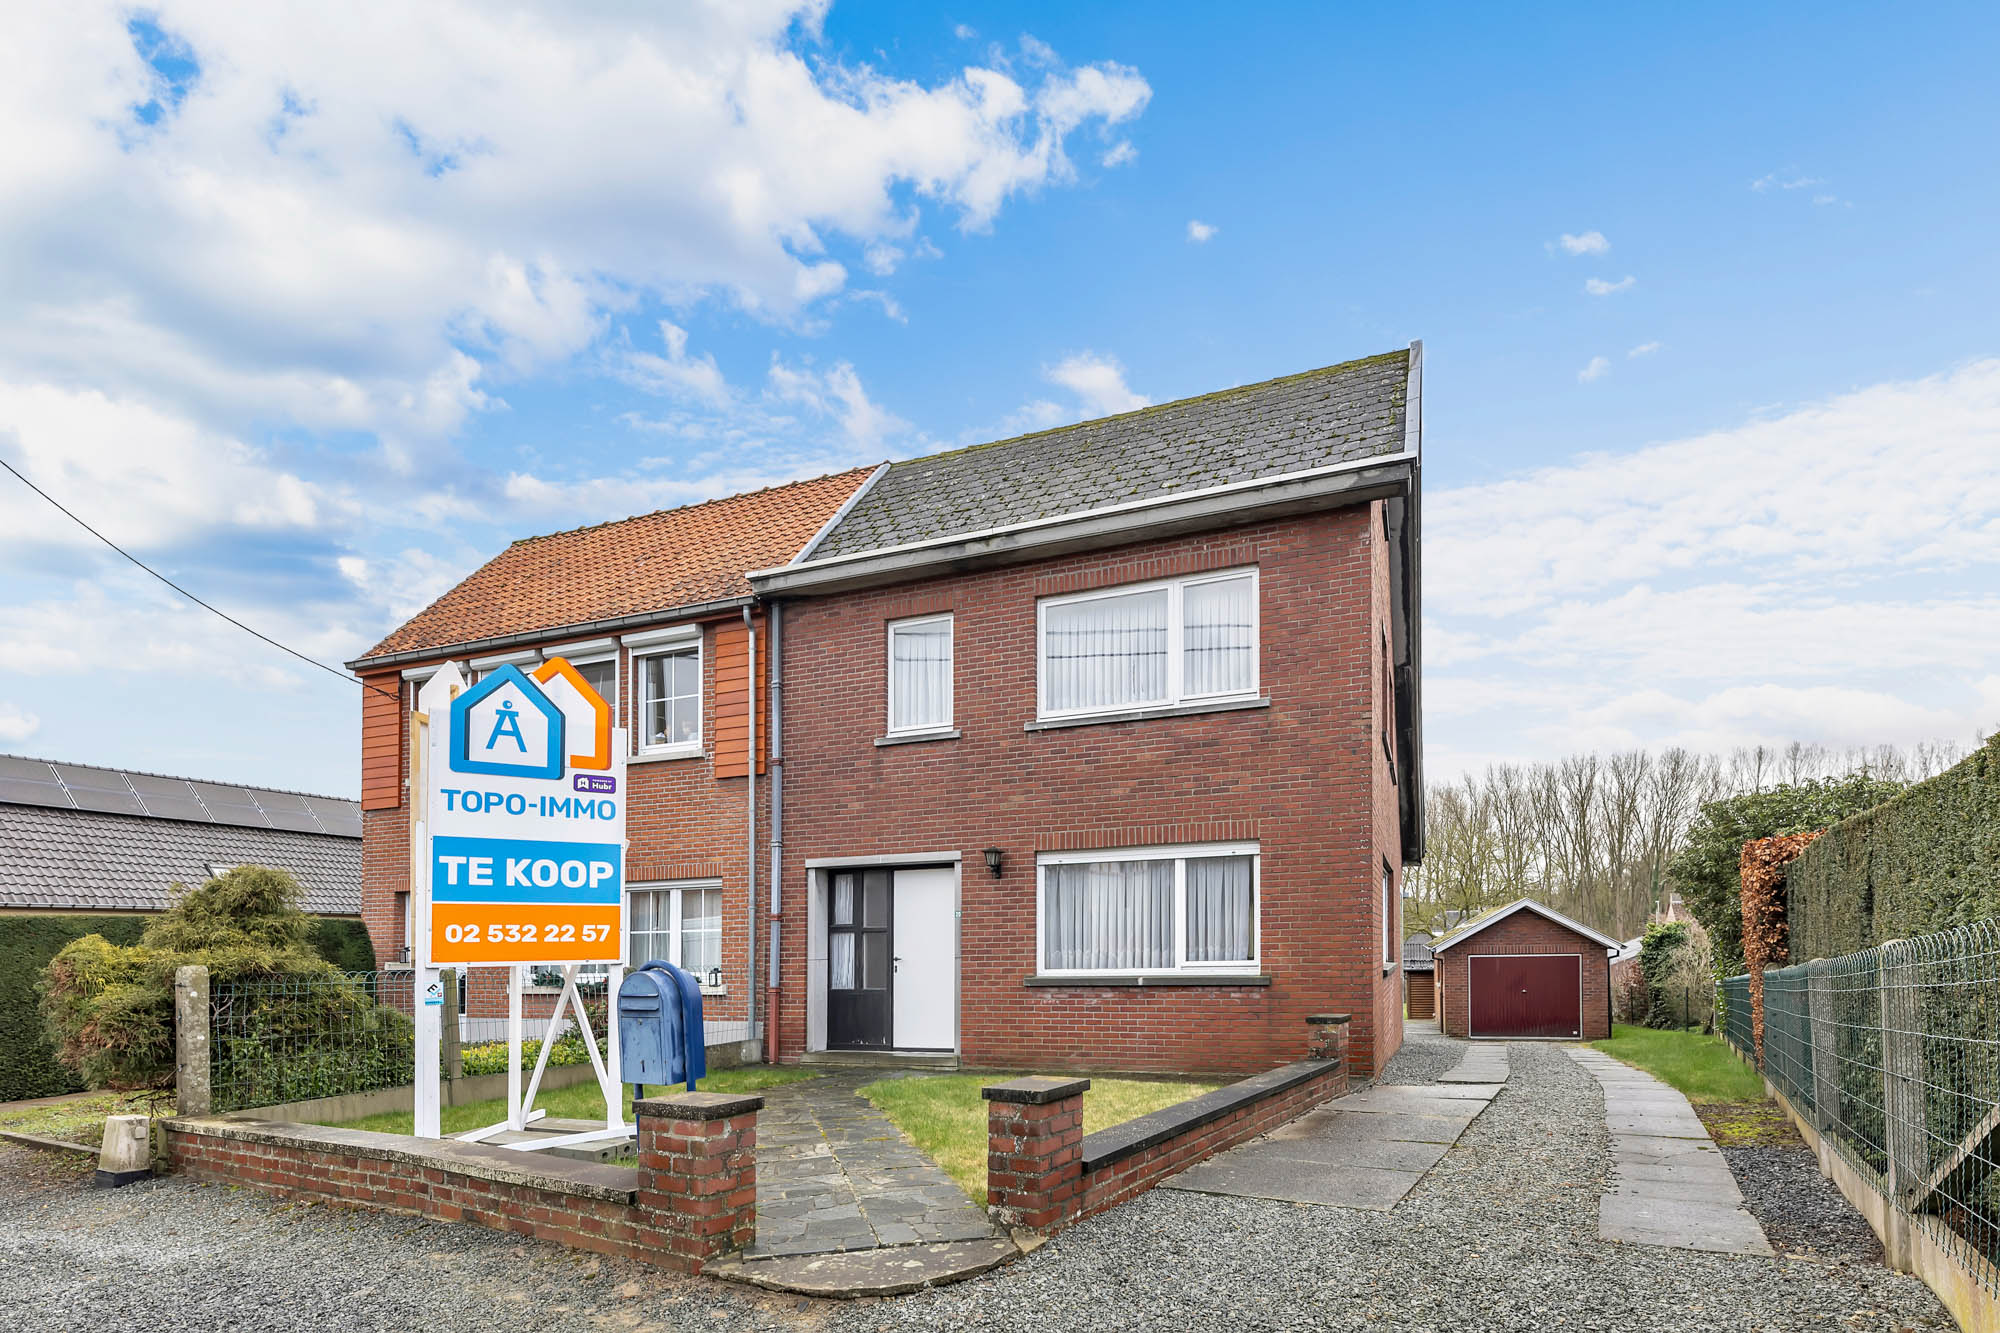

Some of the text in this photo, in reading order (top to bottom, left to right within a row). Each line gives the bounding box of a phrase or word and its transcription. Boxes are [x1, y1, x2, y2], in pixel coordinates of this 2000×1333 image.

[592, 782, 612, 790] Hubr
[440, 788, 616, 821] TOPO-IMMO
[438, 855, 614, 889] TE KOOP
[445, 924, 611, 943] 02 532 22 57
